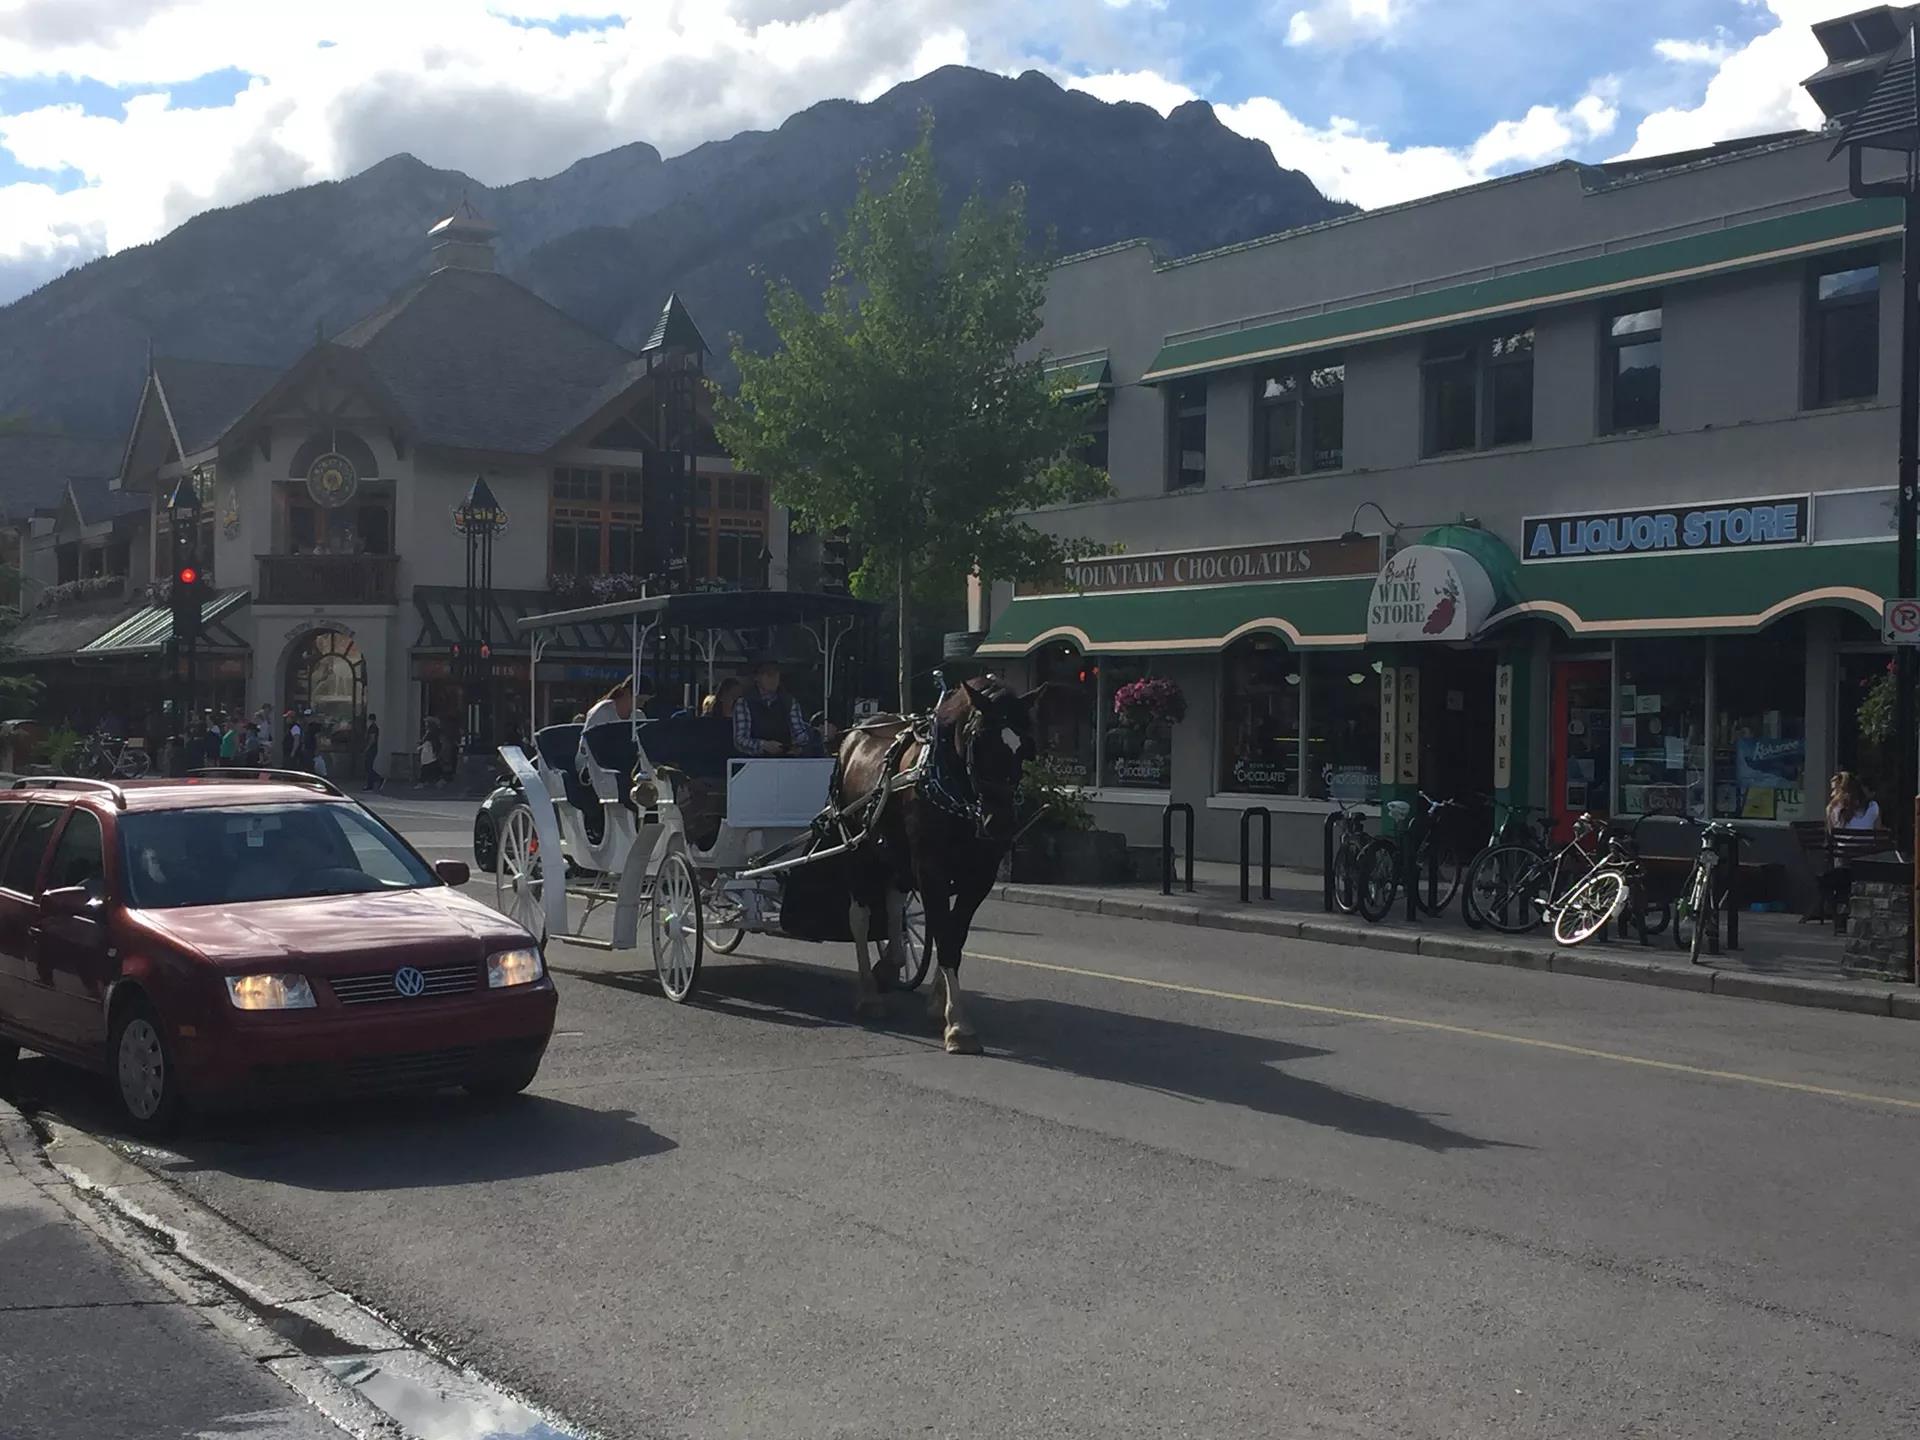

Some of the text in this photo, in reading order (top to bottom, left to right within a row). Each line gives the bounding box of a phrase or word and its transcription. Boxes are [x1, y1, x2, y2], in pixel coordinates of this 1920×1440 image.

[1529, 503, 1800, 557] A LIQUOR STORE
[1065, 548, 1312, 587] MOUNTAIN CHOCOLATES
[1385, 558, 1417, 583] Banff
[1378, 582, 1421, 603] WINE
[1371, 603, 1426, 625] STORE
